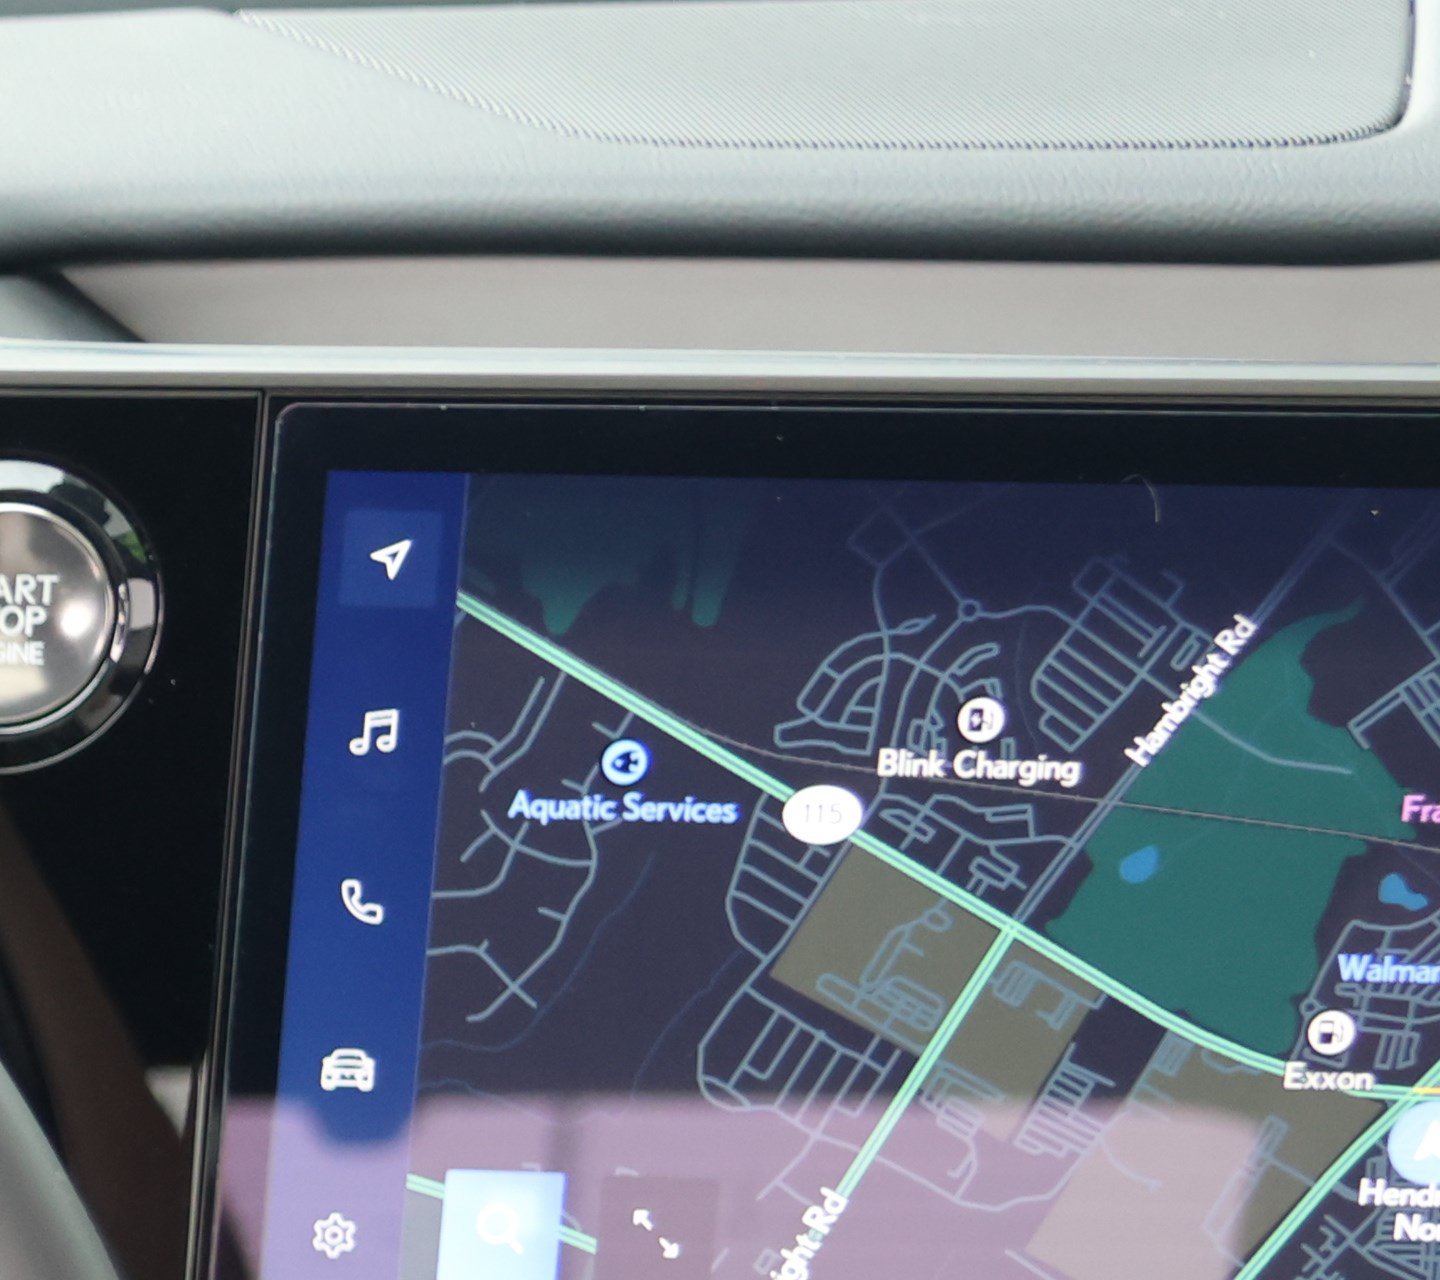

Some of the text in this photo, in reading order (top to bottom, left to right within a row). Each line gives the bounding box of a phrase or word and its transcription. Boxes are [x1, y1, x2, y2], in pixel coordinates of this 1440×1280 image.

[1124, 613, 1258, 768] Hambright Rd
[877, 748, 1082, 787] Blink Charging
[507, 788, 739, 826] Aquatic Services
[802, 803, 845, 826] 115
[1284, 1061, 1375, 1092] Exxon
[801, 1186, 849, 1235] Rd
[1393, 1212, 1440, 1243] No
